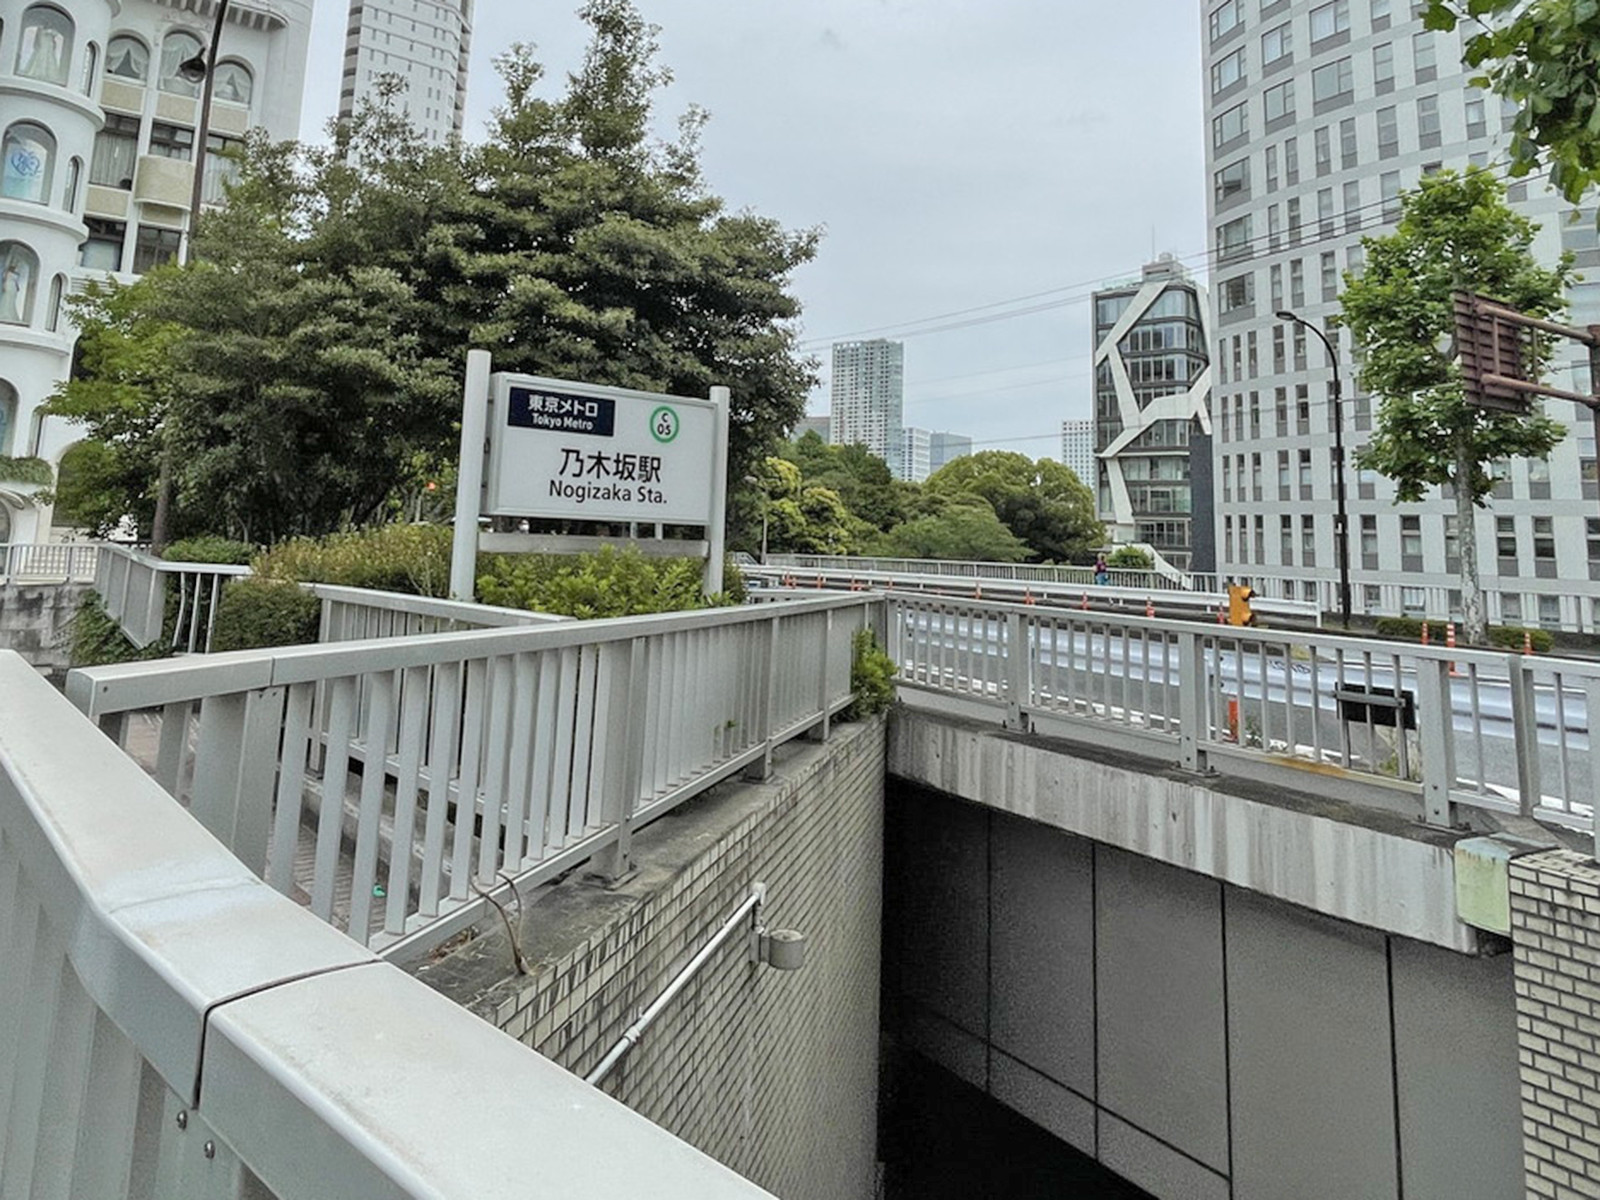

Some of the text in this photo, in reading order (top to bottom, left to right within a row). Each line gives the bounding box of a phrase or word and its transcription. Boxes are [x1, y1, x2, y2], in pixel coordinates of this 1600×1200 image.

[528, 394, 598, 417] 東京メトロ
[532, 412, 593, 430] Tokyo Metro
[661, 412, 669, 423] C
[657, 423, 671, 435] 05
[559, 448, 661, 483] 乃木坂駅
[549, 479, 667, 504] Nogizaka Sta.
